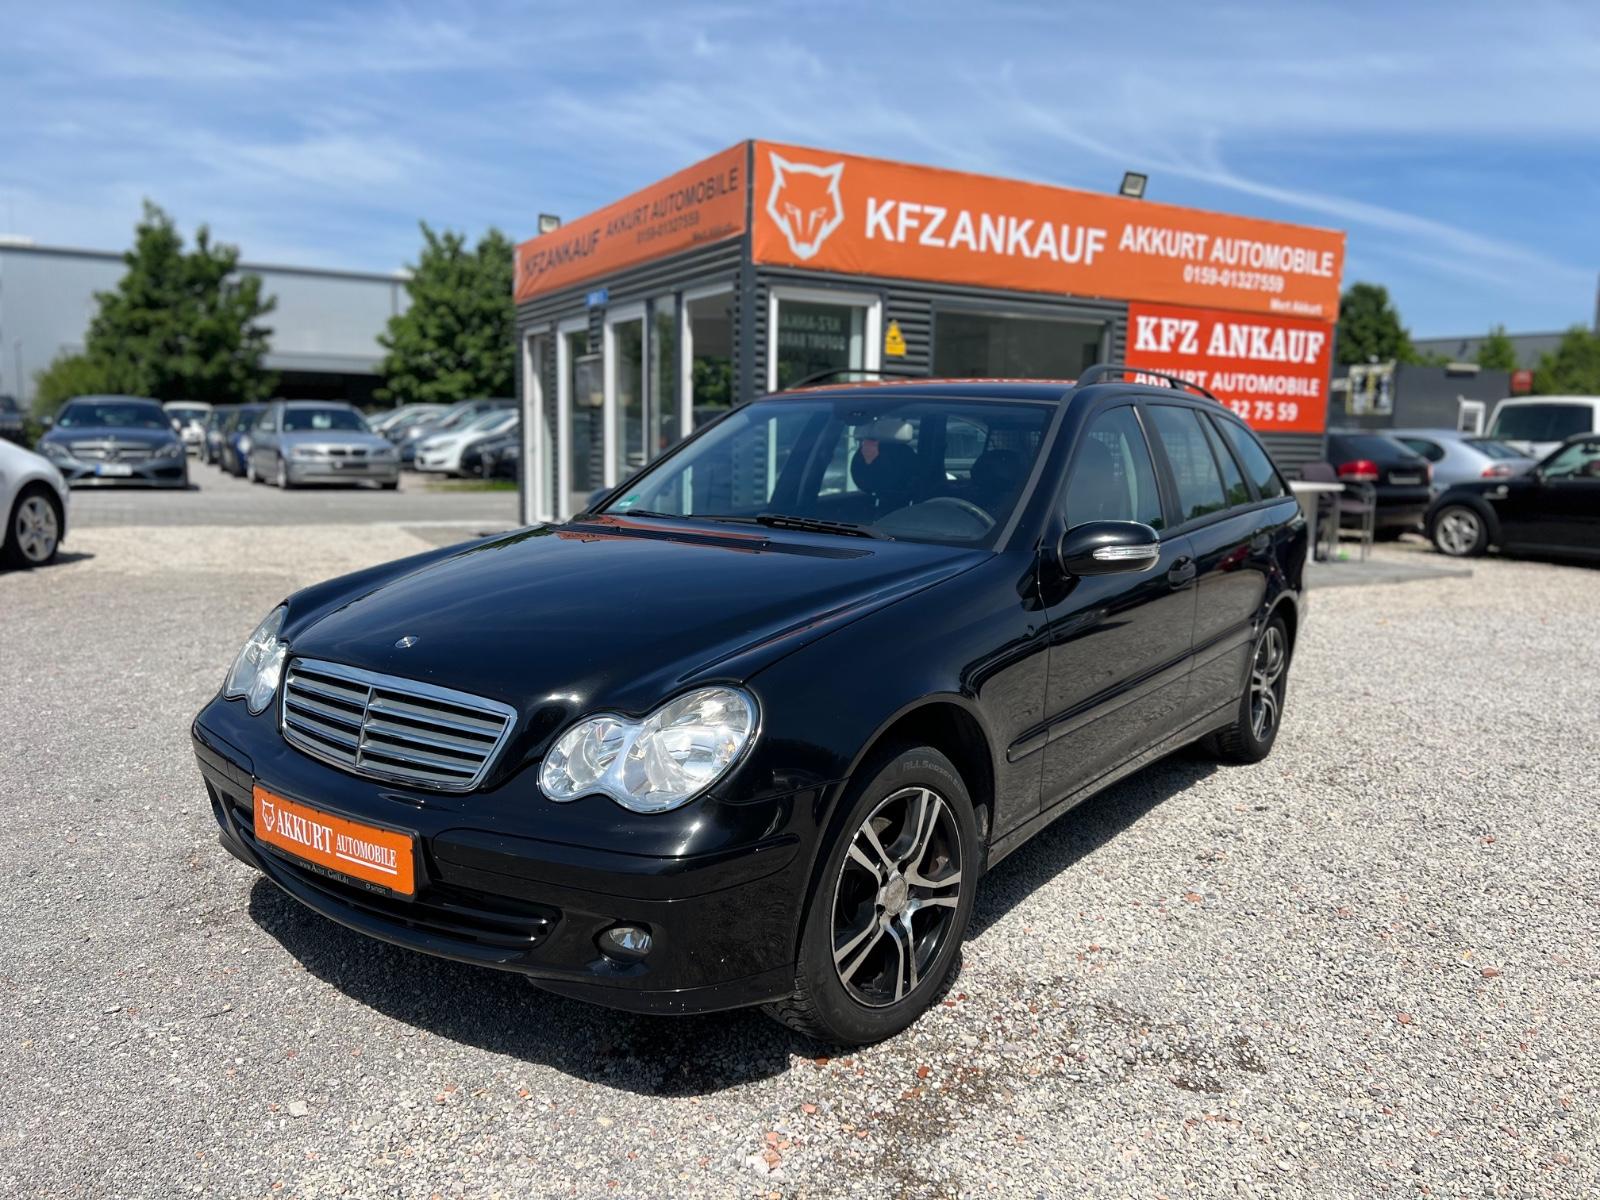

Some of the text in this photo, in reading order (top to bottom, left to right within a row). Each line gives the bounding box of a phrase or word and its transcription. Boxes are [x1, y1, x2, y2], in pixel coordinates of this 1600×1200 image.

[606, 205, 650, 236] AKKURT
[652, 167, 739, 218] AUTOMOBILE
[525, 229, 600, 277] KFZANKAUF
[865, 196, 1107, 267] KFZANKAUF
[1119, 224, 1334, 277] AKKURT AUTOMOBILE
[1183, 264, 1285, 293] 0159-01327559
[1134, 315, 1325, 364] KFZ ANKAUF
[1210, 371, 1320, 397] AUTOMOBILE
[1254, 400, 1275, 421] 75
[1277, 401, 1299, 422] 59
[276, 808, 397, 868] AKKURT AUTOMOBILE
